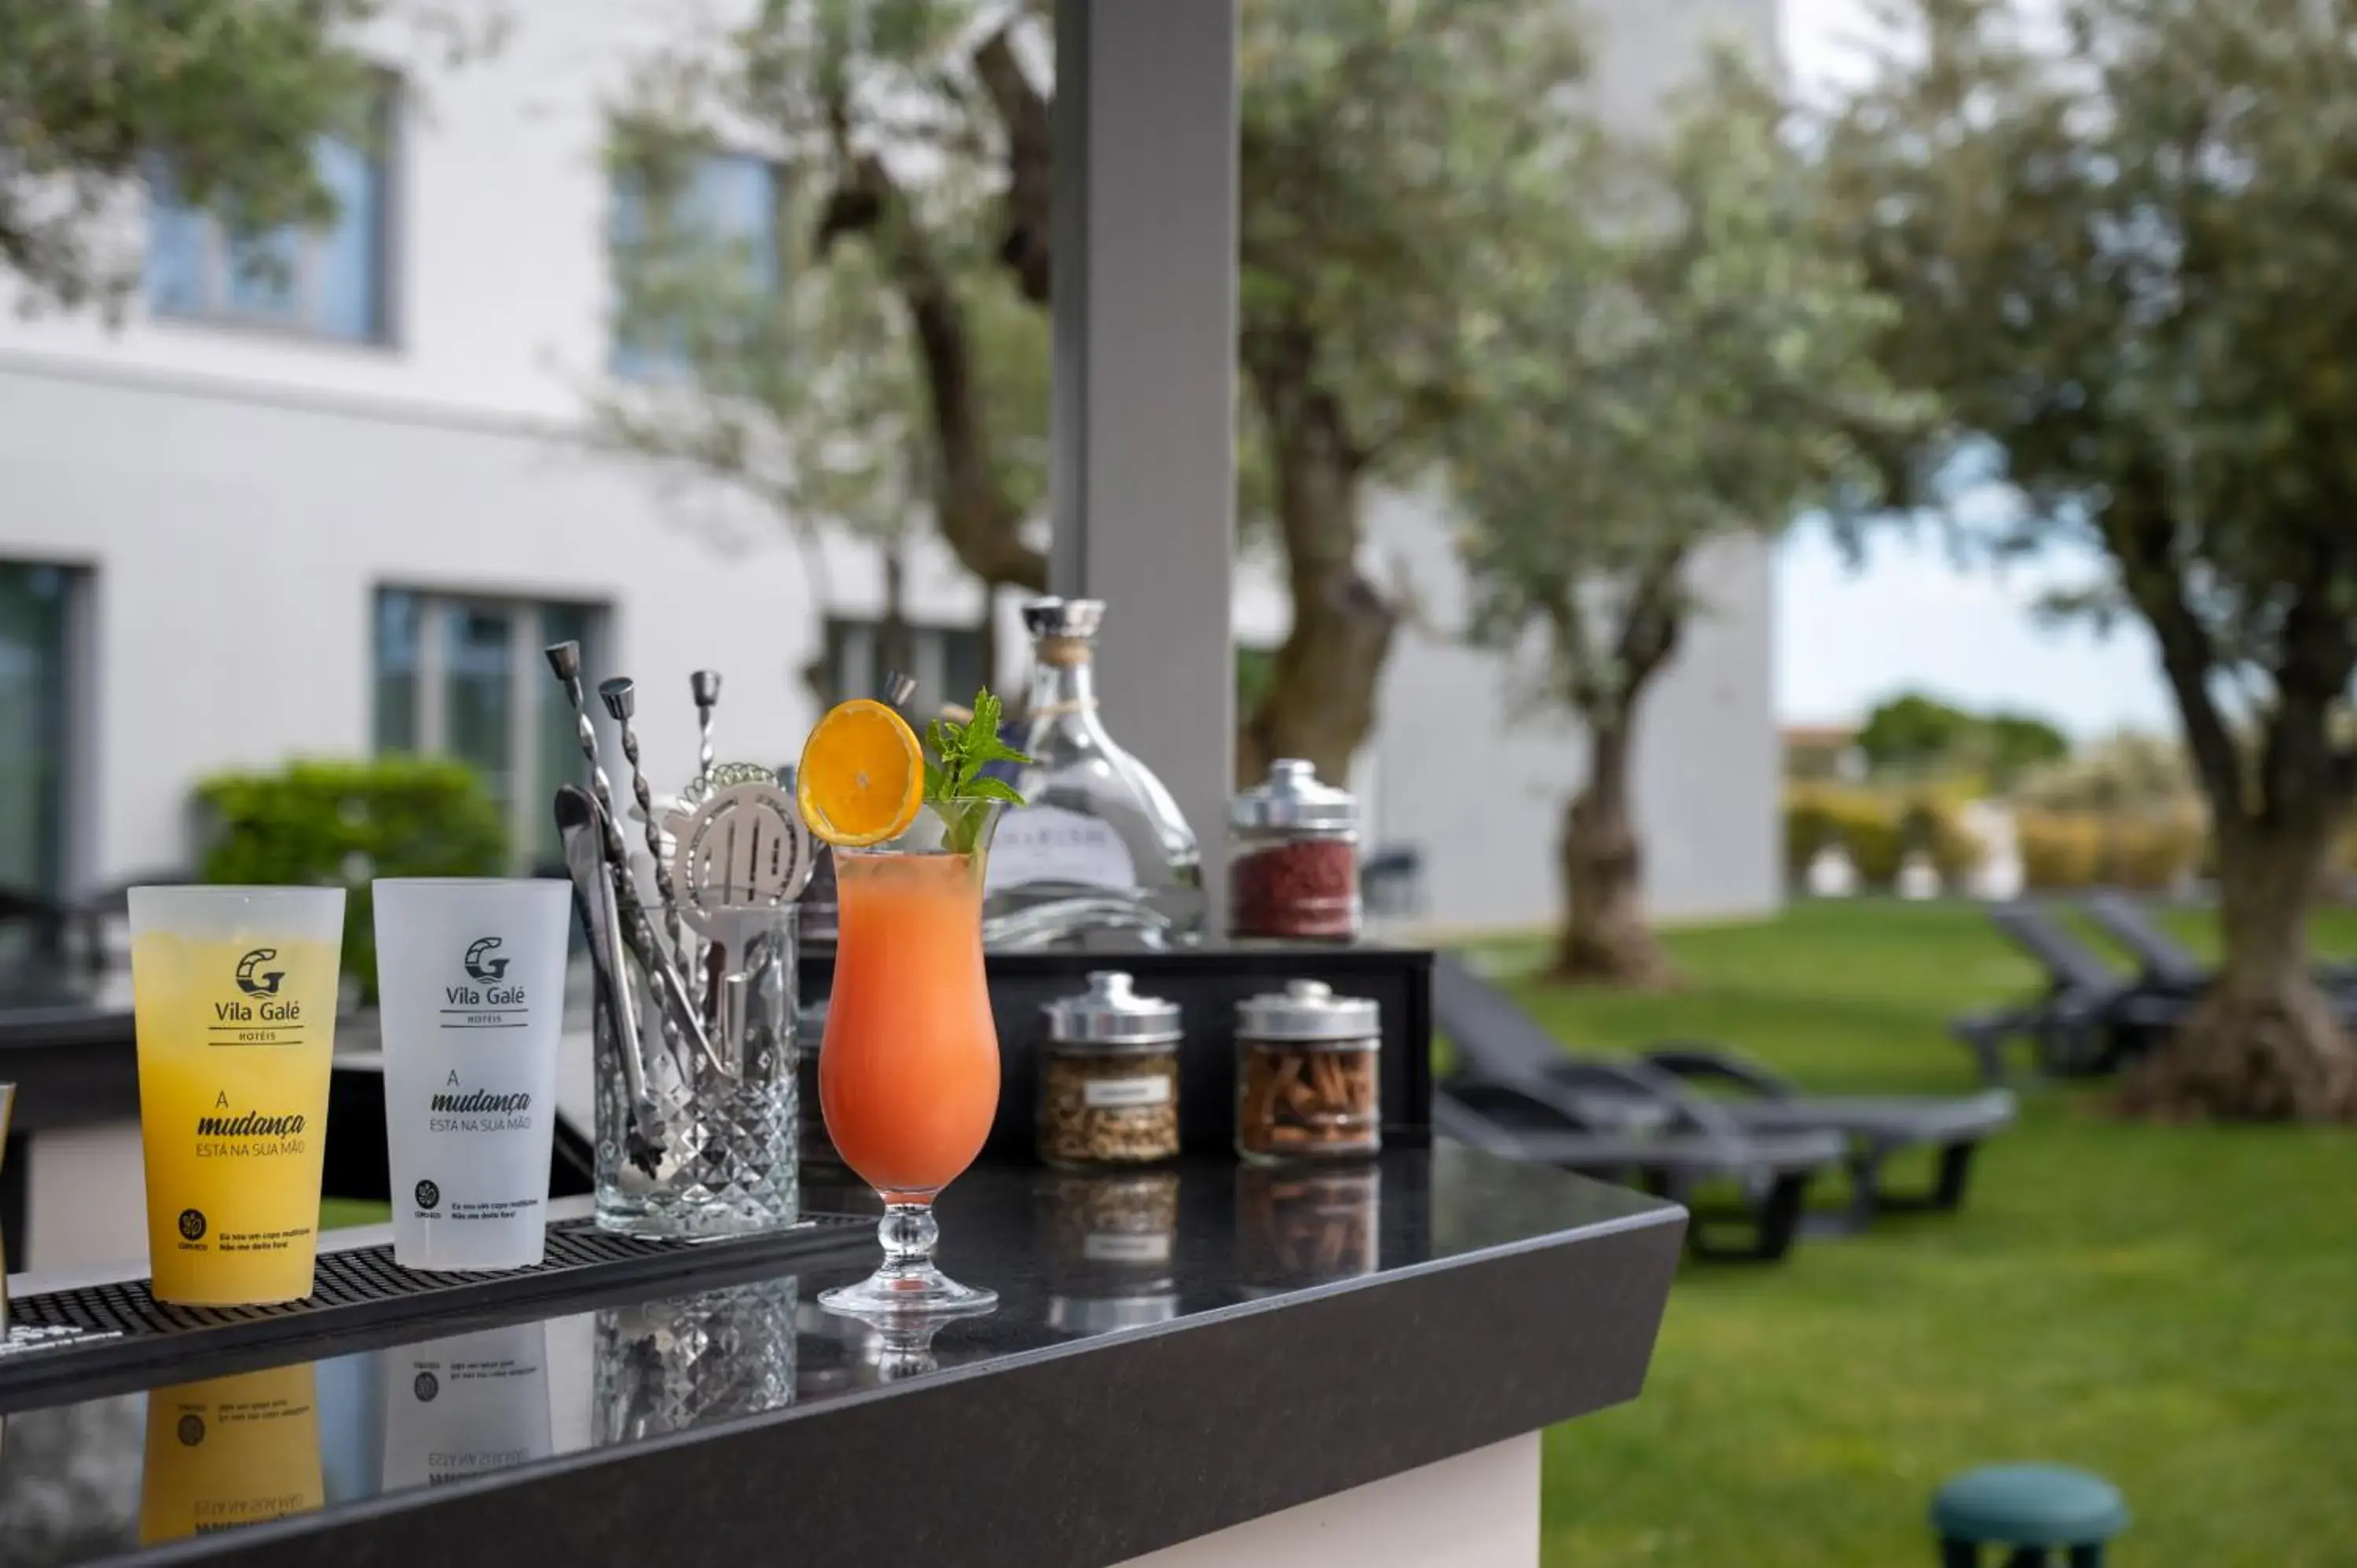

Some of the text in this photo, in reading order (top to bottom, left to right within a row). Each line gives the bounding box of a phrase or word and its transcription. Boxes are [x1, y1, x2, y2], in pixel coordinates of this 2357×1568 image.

[446, 986, 525, 1004] Vila Galé
[215, 1001, 300, 1020] Vila Galé
[239, 1031, 276, 1041] HOTÉIS
[447, 1069, 459, 1086] A
[215, 1090, 229, 1108] A
[431, 1088, 532, 1115] mudança
[197, 1110, 305, 1139] mudança
[462, 1119, 478, 1131] NA
[480, 1118, 504, 1131] SUA
[230, 1143, 249, 1156] NA
[251, 1143, 279, 1156] SUA
